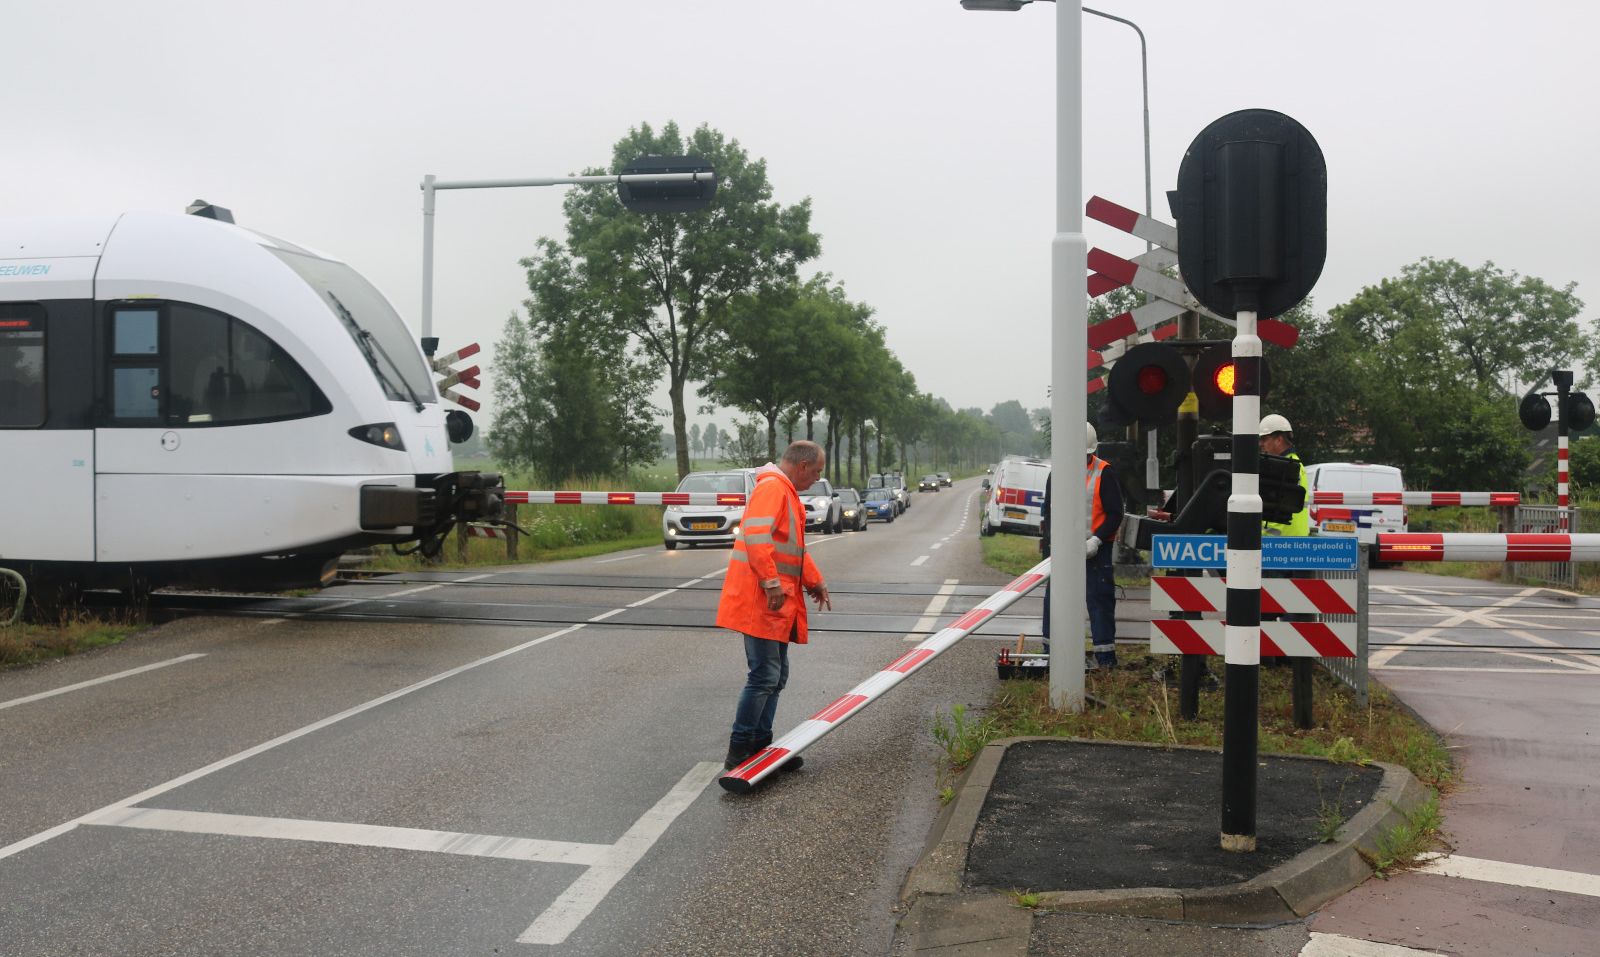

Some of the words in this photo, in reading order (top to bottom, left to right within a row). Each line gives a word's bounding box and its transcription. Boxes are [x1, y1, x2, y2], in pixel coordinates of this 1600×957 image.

[1274, 541, 1291, 550] rode
[1293, 541, 1310, 550] licht
[1312, 542, 1343, 552] gedoofd
[1345, 542, 1352, 550] is
[1273, 555, 1288, 564] nog
[1290, 555, 1304, 563] een
[1305, 555, 1325, 563] trein
[1326, 555, 1352, 563] komen
